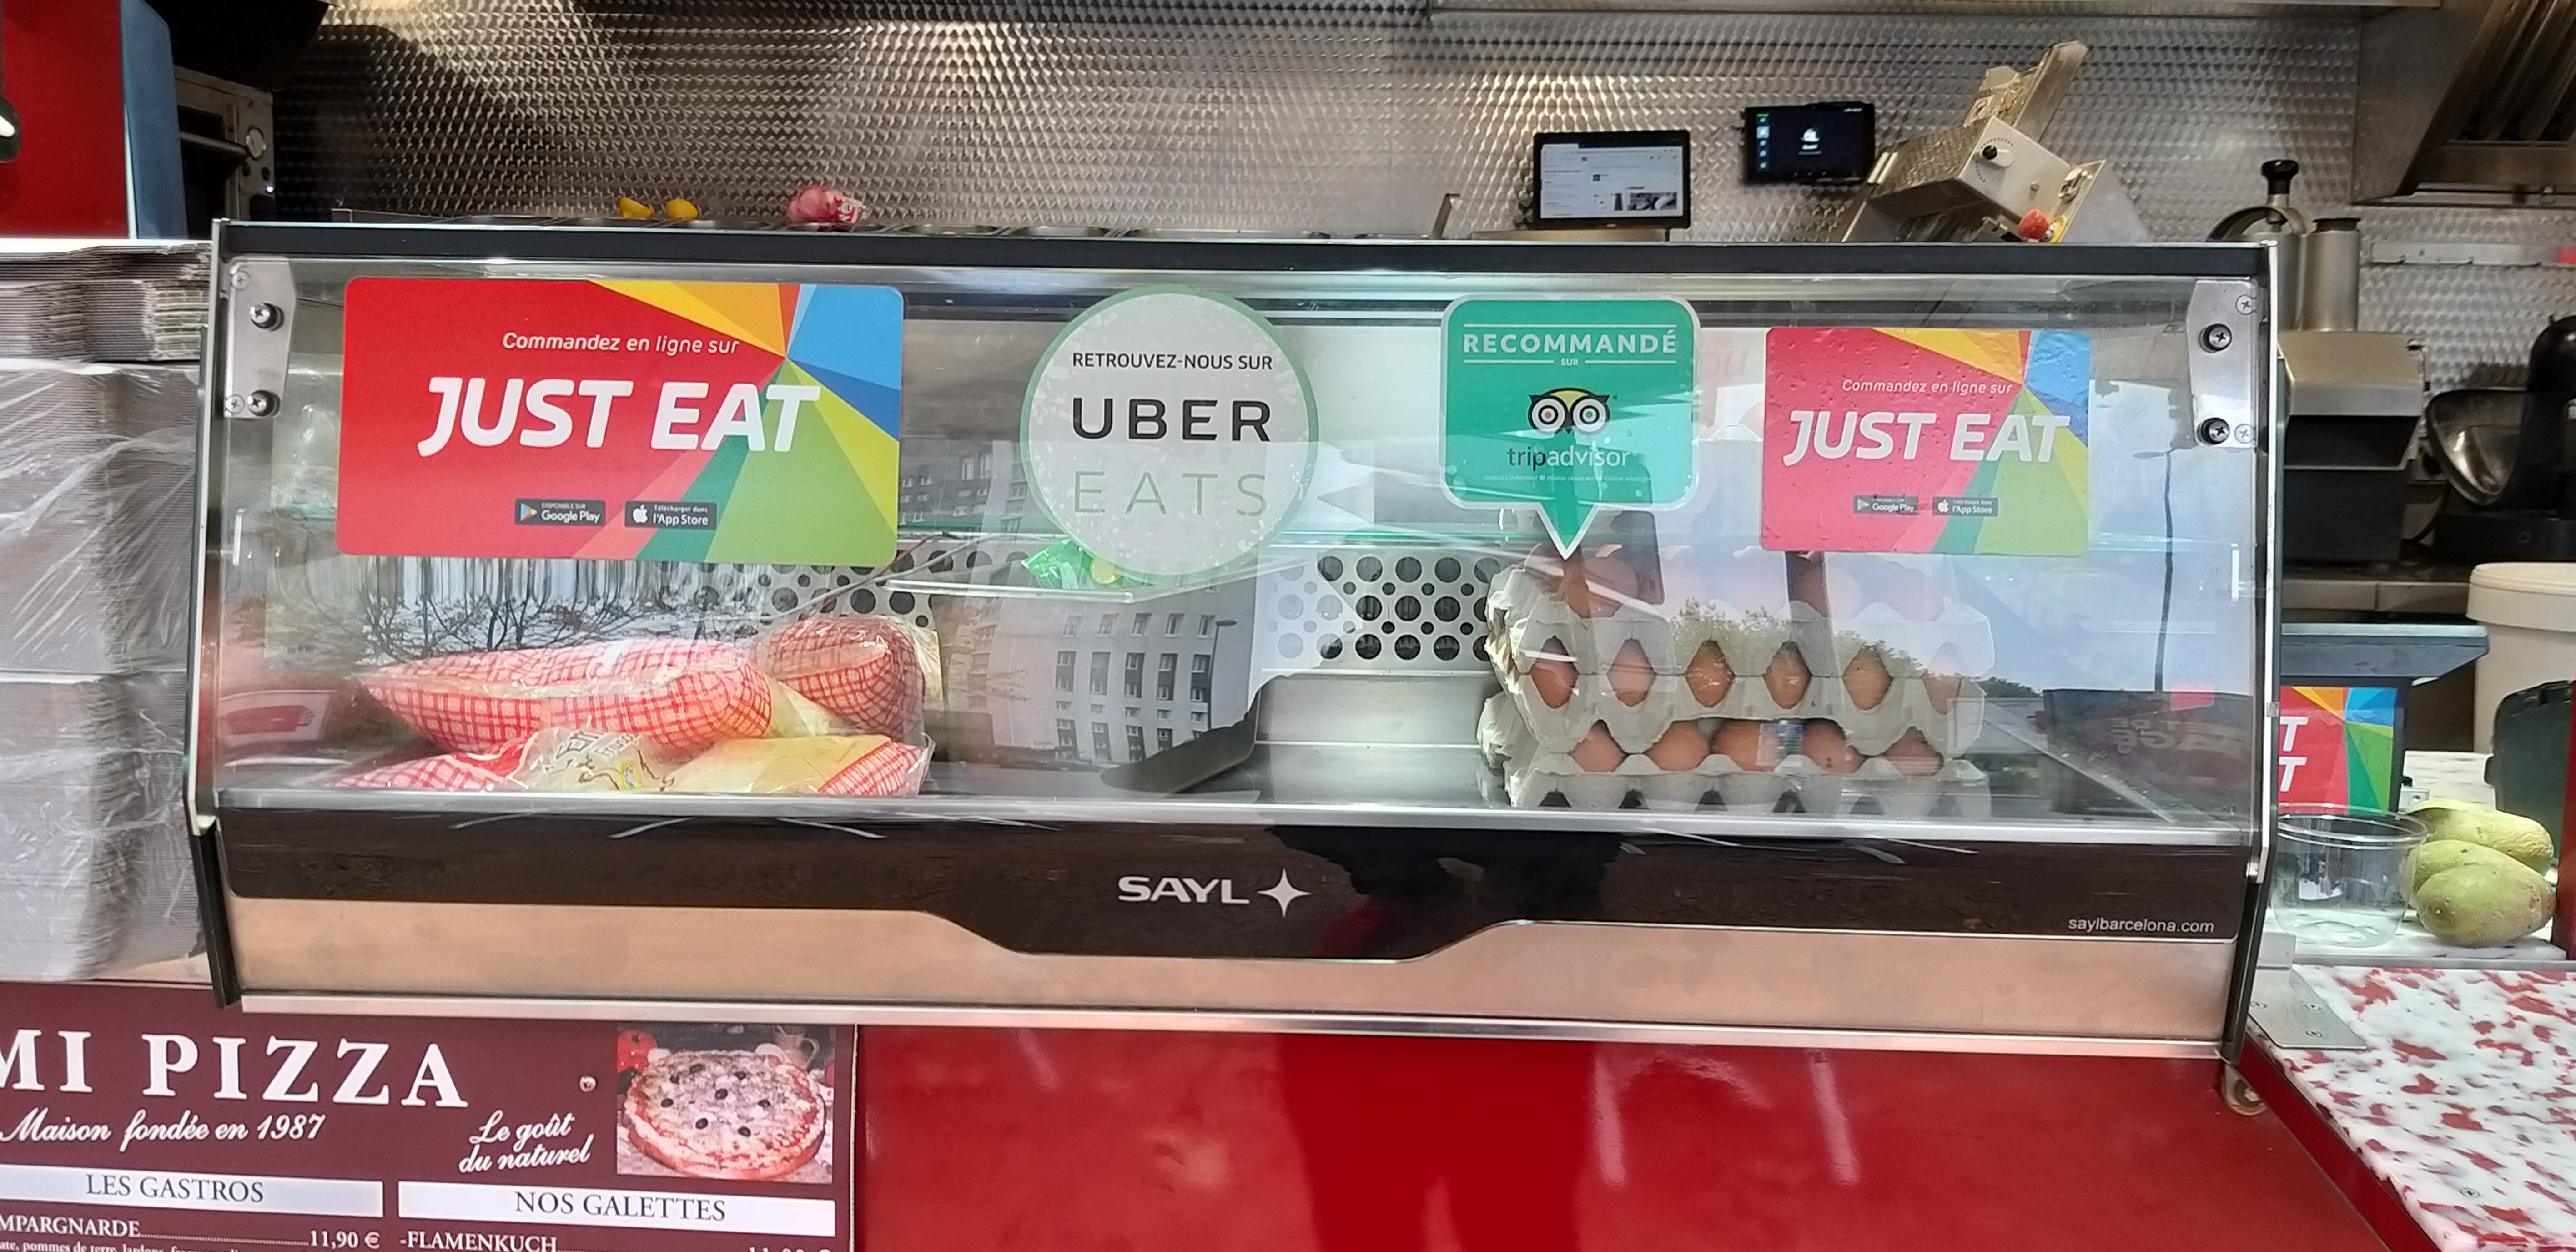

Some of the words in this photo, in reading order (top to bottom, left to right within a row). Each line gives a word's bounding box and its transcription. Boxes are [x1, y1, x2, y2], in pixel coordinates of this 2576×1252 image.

[503, 332, 621, 351] Commandez
[626, 338, 650, 352] en
[655, 335, 703, 357] ligne
[708, 340, 740, 354] sur
[1463, 329, 1677, 354] RECOMMANDÉ
[1072, 352, 1233, 370] RETROUVEZ-NOUS
[1238, 355, 1273, 370] SUR
[1560, 358, 1579, 367] SUR
[1842, 379, 1927, 393] Commandez
[1931, 384, 1948, 393] en
[1952, 381, 1986, 396] ligne
[1990, 384, 2012, 394] sur
[417, 377, 633, 457] JUST
[650, 381, 821, 453] EAT
[1072, 397, 1271, 442] UBER
[1782, 411, 1937, 466] JUST
[1950, 413, 2070, 463] EAT
[1507, 444, 1631, 471] tripadvisor
[1073, 470, 1267, 517] EATS
[541, 510, 578, 524] Google
[579, 510, 601, 524] Play
[681, 514, 709, 525] Store
[1872, 502, 1898, 513] Google
[1900, 503, 1914, 513] Play
[1972, 505, 1992, 514] Store
[1117, 876, 1250, 904] SAYL
[2068, 917, 2214, 933] saylbarcelona.com
[141, 1033, 468, 1108] PIZZA
[0, 1107, 112, 1142] Maison
[119, 1108, 210, 1152] fondée
[215, 1121, 249, 1140] en
[257, 1113, 327, 1140] 1987
[469, 1109, 511, 1144] Le
[513, 1112, 576, 1152] goût
[458, 1143, 493, 1173] du
[497, 1134, 594, 1170] naturel
[86, 1174, 131, 1196] LES
[140, 1176, 264, 1203] GASTROS
[515, 1191, 574, 1214] NOS
[583, 1194, 726, 1222] GALETTES
[73, 1241, 87, 1252] de
[310, 1230, 359, 1250] 11,90
[364, 1231, 381, 1250] €
[400, 1230, 557, 1252] -FLAMENKUCH
